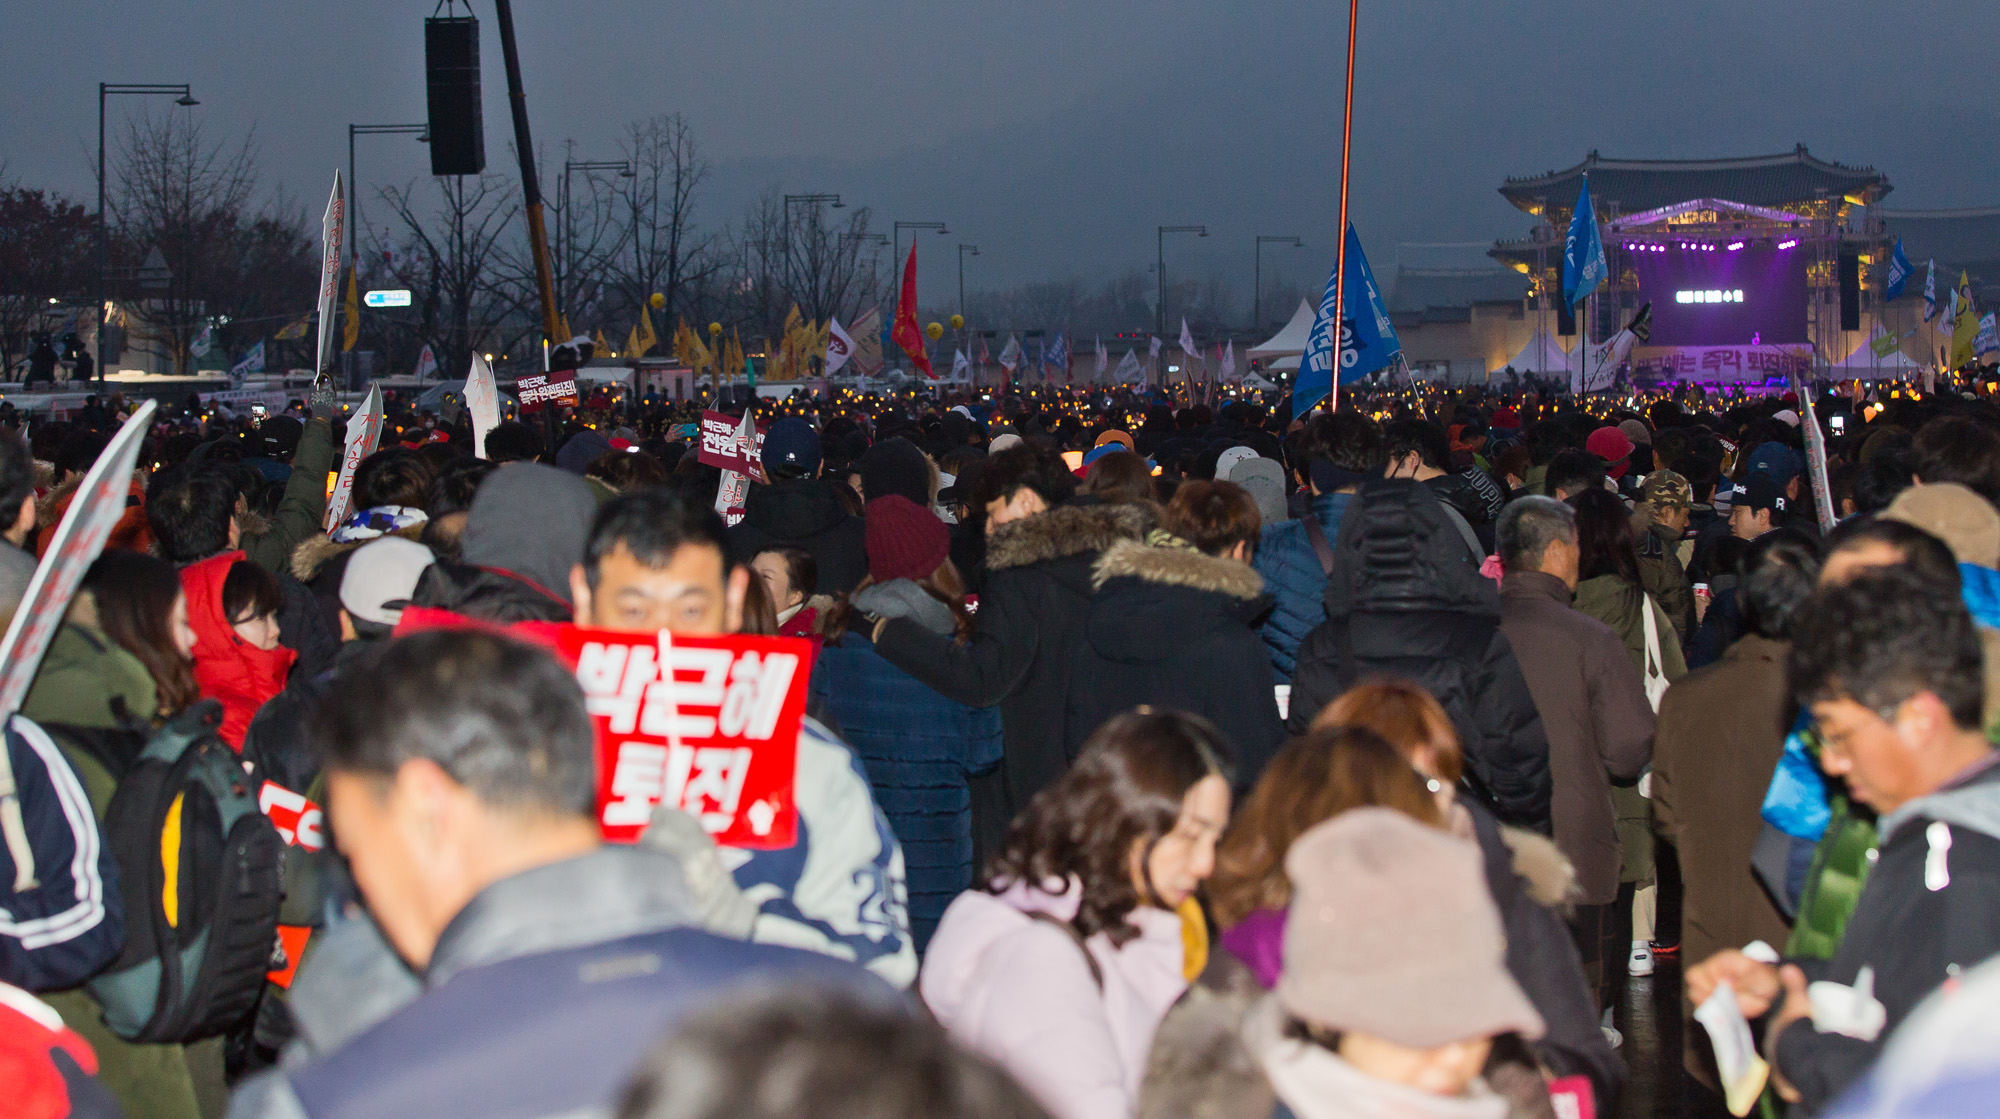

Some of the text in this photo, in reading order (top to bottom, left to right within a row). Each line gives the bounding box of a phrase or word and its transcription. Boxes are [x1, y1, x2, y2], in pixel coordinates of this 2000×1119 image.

[1775, 497, 1786, 511] R
[576, 641, 799, 741] 박근혜
[602, 741, 753, 834] 퇴진
